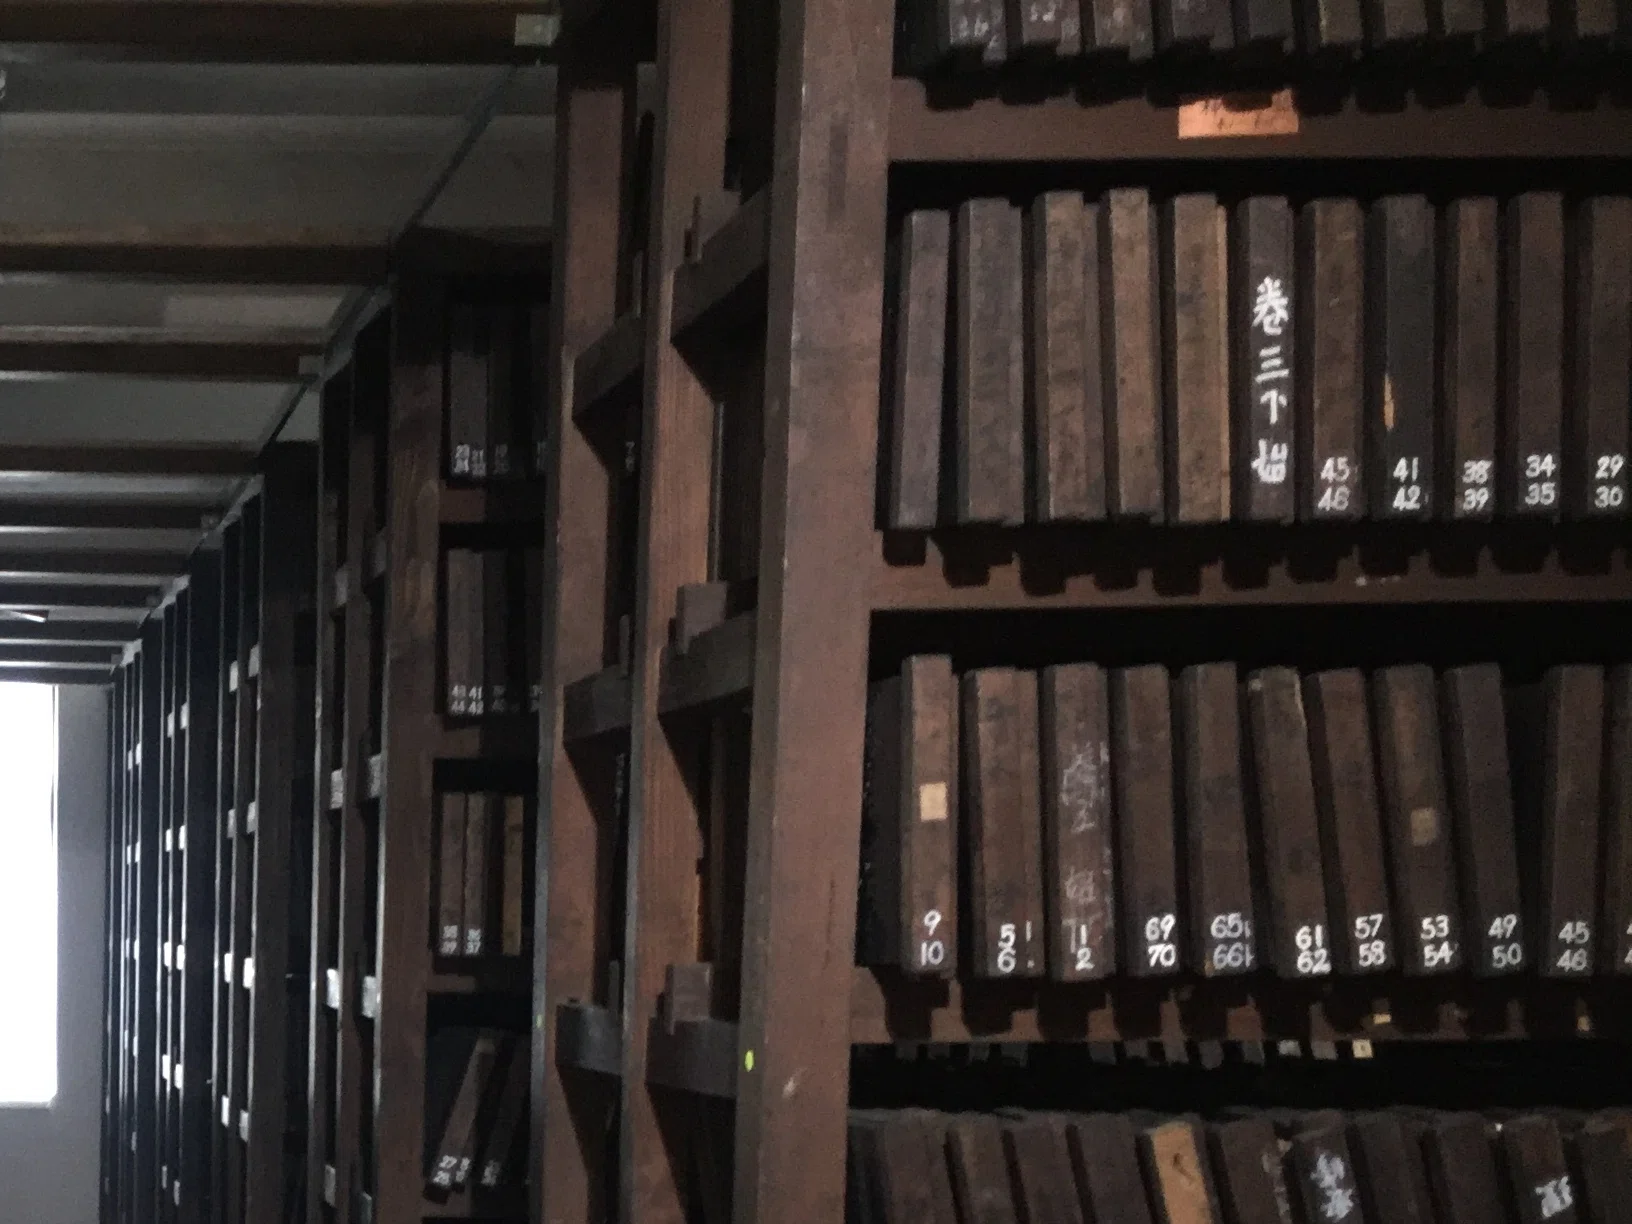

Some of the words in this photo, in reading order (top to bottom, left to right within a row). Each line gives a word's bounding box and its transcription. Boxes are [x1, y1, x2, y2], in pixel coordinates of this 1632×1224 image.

[1320, 456, 1351, 483] 45
[1392, 457, 1419, 482] 41
[1525, 453, 1557, 478] 34
[1595, 454, 1624, 479] 29
[1392, 484, 1421, 511] 42
[1524, 481, 1556, 506] 35
[1594, 485, 1623, 508] 30
[923, 909, 943, 936] 9
[998, 922, 1016, 949] 5
[1080, 924, 1088, 946] 1
[1145, 913, 1176, 942] 69
[1209, 912, 1244, 940] 65
[1354, 913, 1384, 940] 57
[1420, 914, 1449, 941] 53
[1488, 913, 1518, 939] 49
[1558, 920, 1591, 944] 45
[1295, 924, 1324, 952] 61
[920, 940, 944, 966] 10
[996, 946, 1016, 973] 6
[1072, 946, 1094, 971] 2
[1147, 942, 1176, 968] 70
[1212, 941, 1245, 970] 66
[1296, 947, 1331, 975] 62
[1358, 939, 1386, 967] 58
[1423, 940, 1453, 967] 54
[1492, 942, 1522, 969] 50
